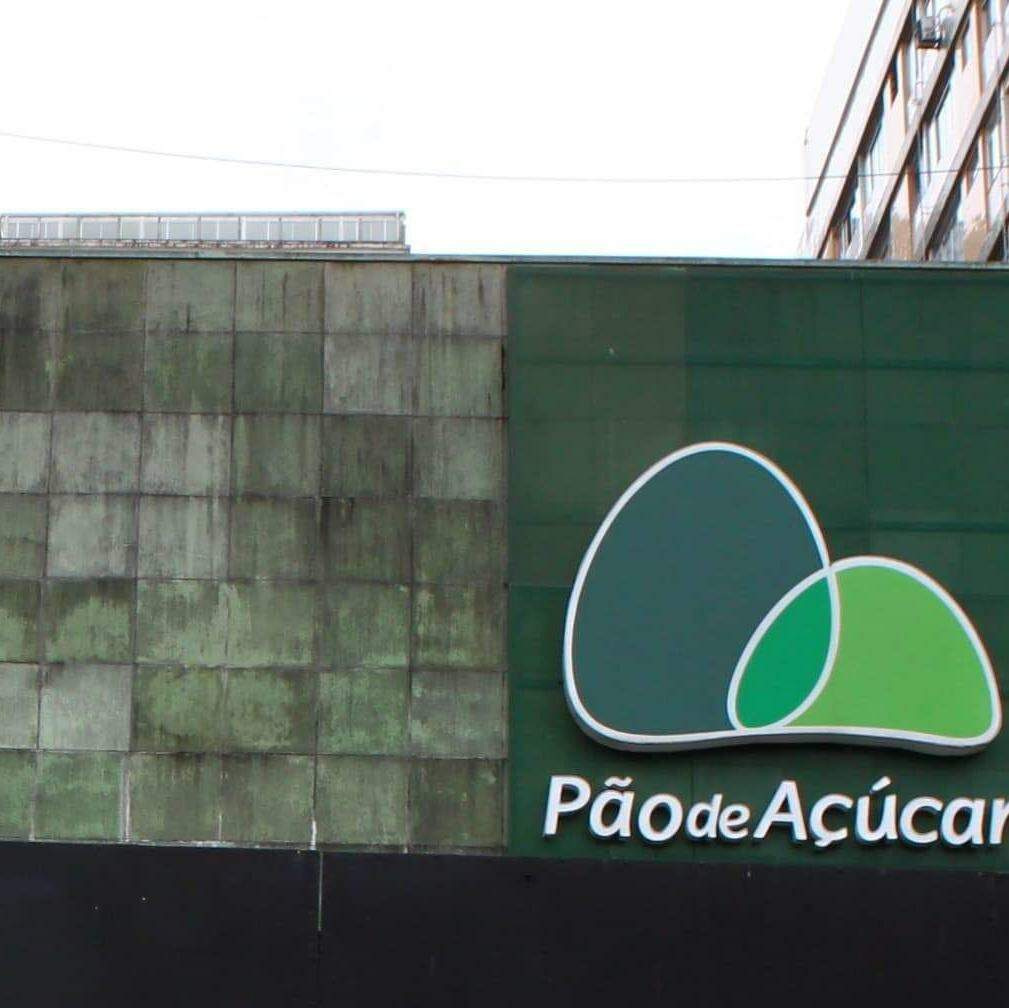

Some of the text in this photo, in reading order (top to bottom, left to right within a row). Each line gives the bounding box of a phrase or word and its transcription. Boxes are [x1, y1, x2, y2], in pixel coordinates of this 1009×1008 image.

[543, 774, 1009, 848] Pão de Açúcar
